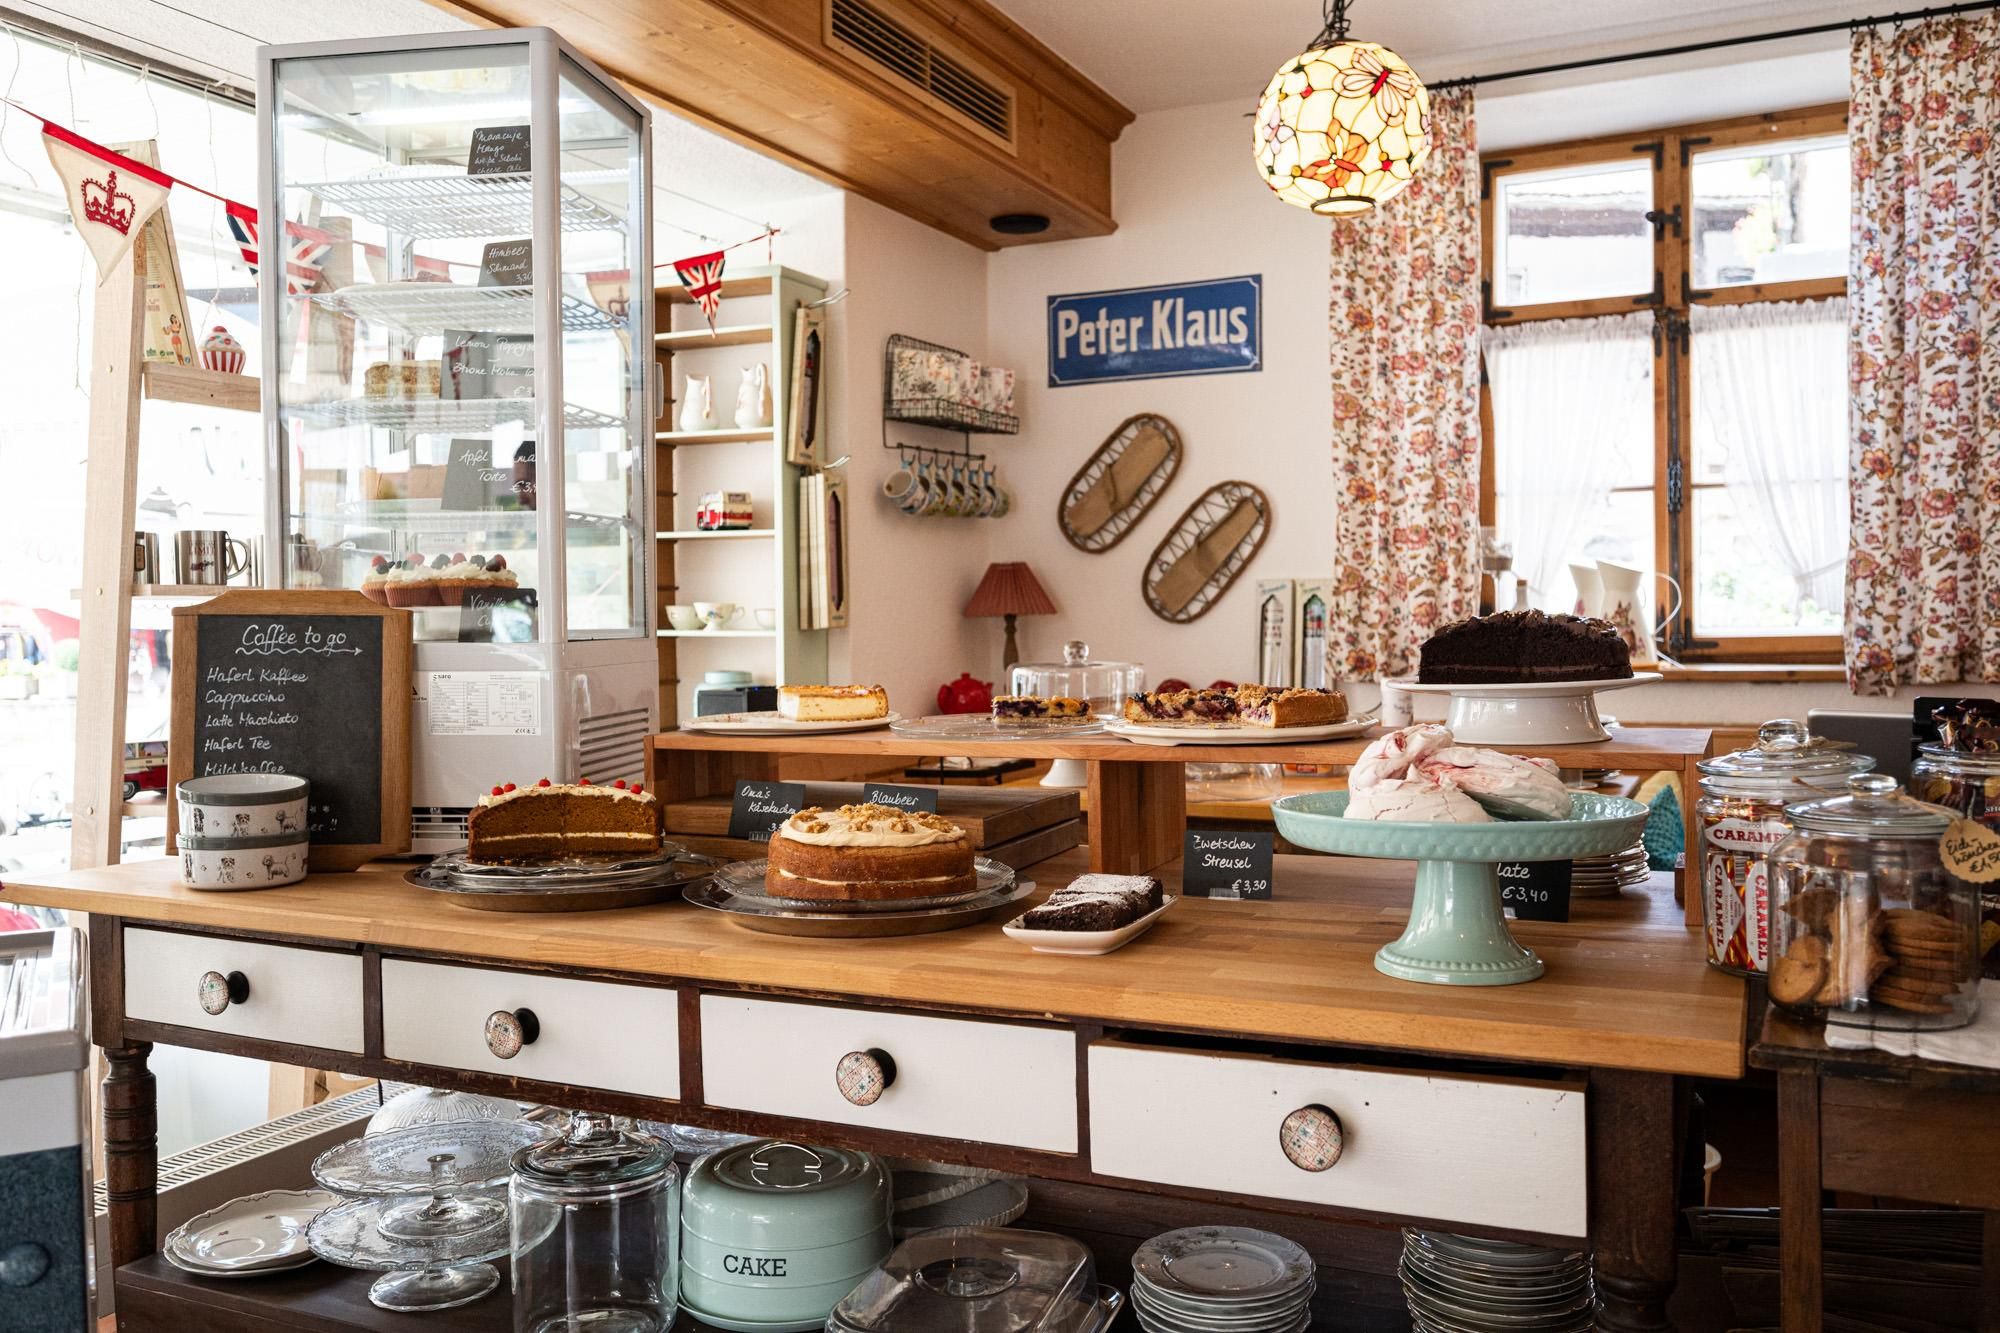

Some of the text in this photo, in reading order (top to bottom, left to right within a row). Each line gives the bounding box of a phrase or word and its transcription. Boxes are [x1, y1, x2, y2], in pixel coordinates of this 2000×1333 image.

[489, 246, 529, 258] Himbeer
[1057, 297, 1249, 359] Peter Klaus
[455, 336, 490, 348] Lemon
[458, 449, 489, 466] Apfel
[477, 468, 508, 482] Torte
[470, 594, 507, 611] Vanille
[242, 624, 347, 657] Coffee to go
[207, 667, 309, 685] Haferl Kaffee
[205, 690, 286, 710] Cappuccino
[205, 711, 299, 727] Latte Macchiato
[204, 736, 272, 752] Haferl Tee
[741, 785, 771, 799] Oma's
[869, 790, 919, 806] Blaubeer
[1193, 834, 1256, 850] Zwetschen
[1713, 829, 1785, 843] CARAME
[1201, 853, 1252, 869] Streusel
[1502, 886, 1548, 902] €3,40
[1714, 864, 1725, 947] CARAMEL
[1755, 874, 1768, 960] CARAMEL
[723, 1254, 787, 1277] CAKE
